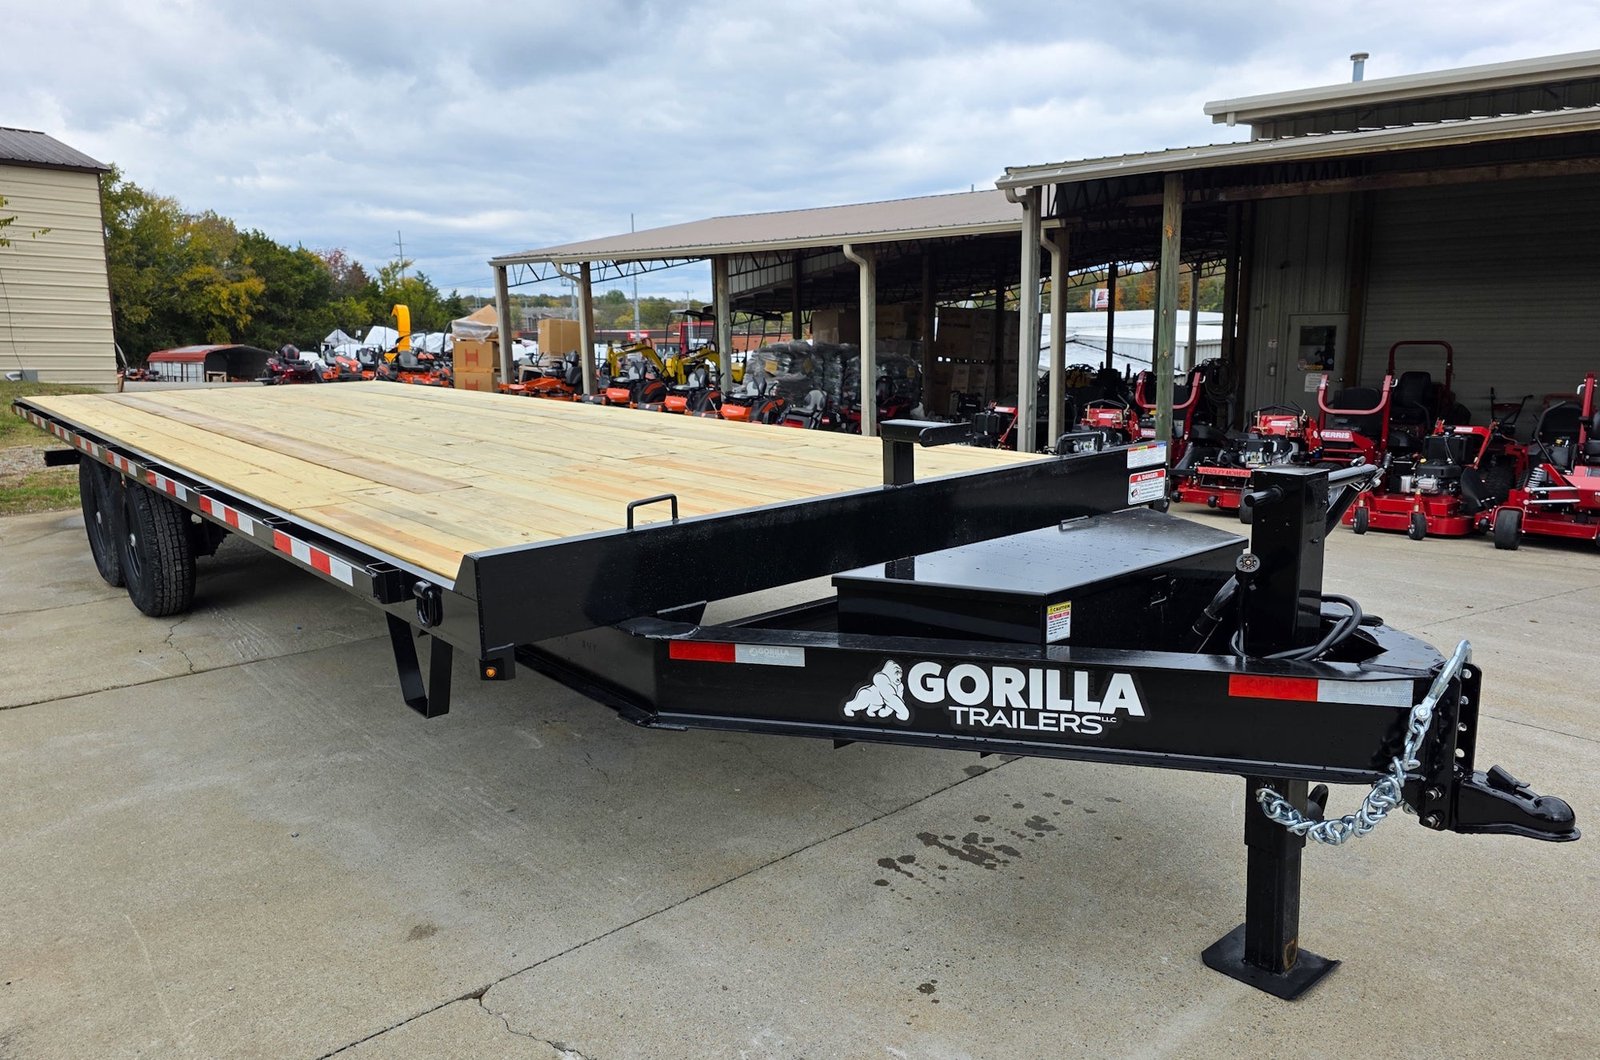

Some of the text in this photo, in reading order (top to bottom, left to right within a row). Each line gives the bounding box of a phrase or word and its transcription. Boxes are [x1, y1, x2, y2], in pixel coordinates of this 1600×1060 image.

[1320, 430, 1350, 439] FERRIS
[907, 661, 1146, 717] GORILLA
[948, 706, 1103, 735] TRAILERS
